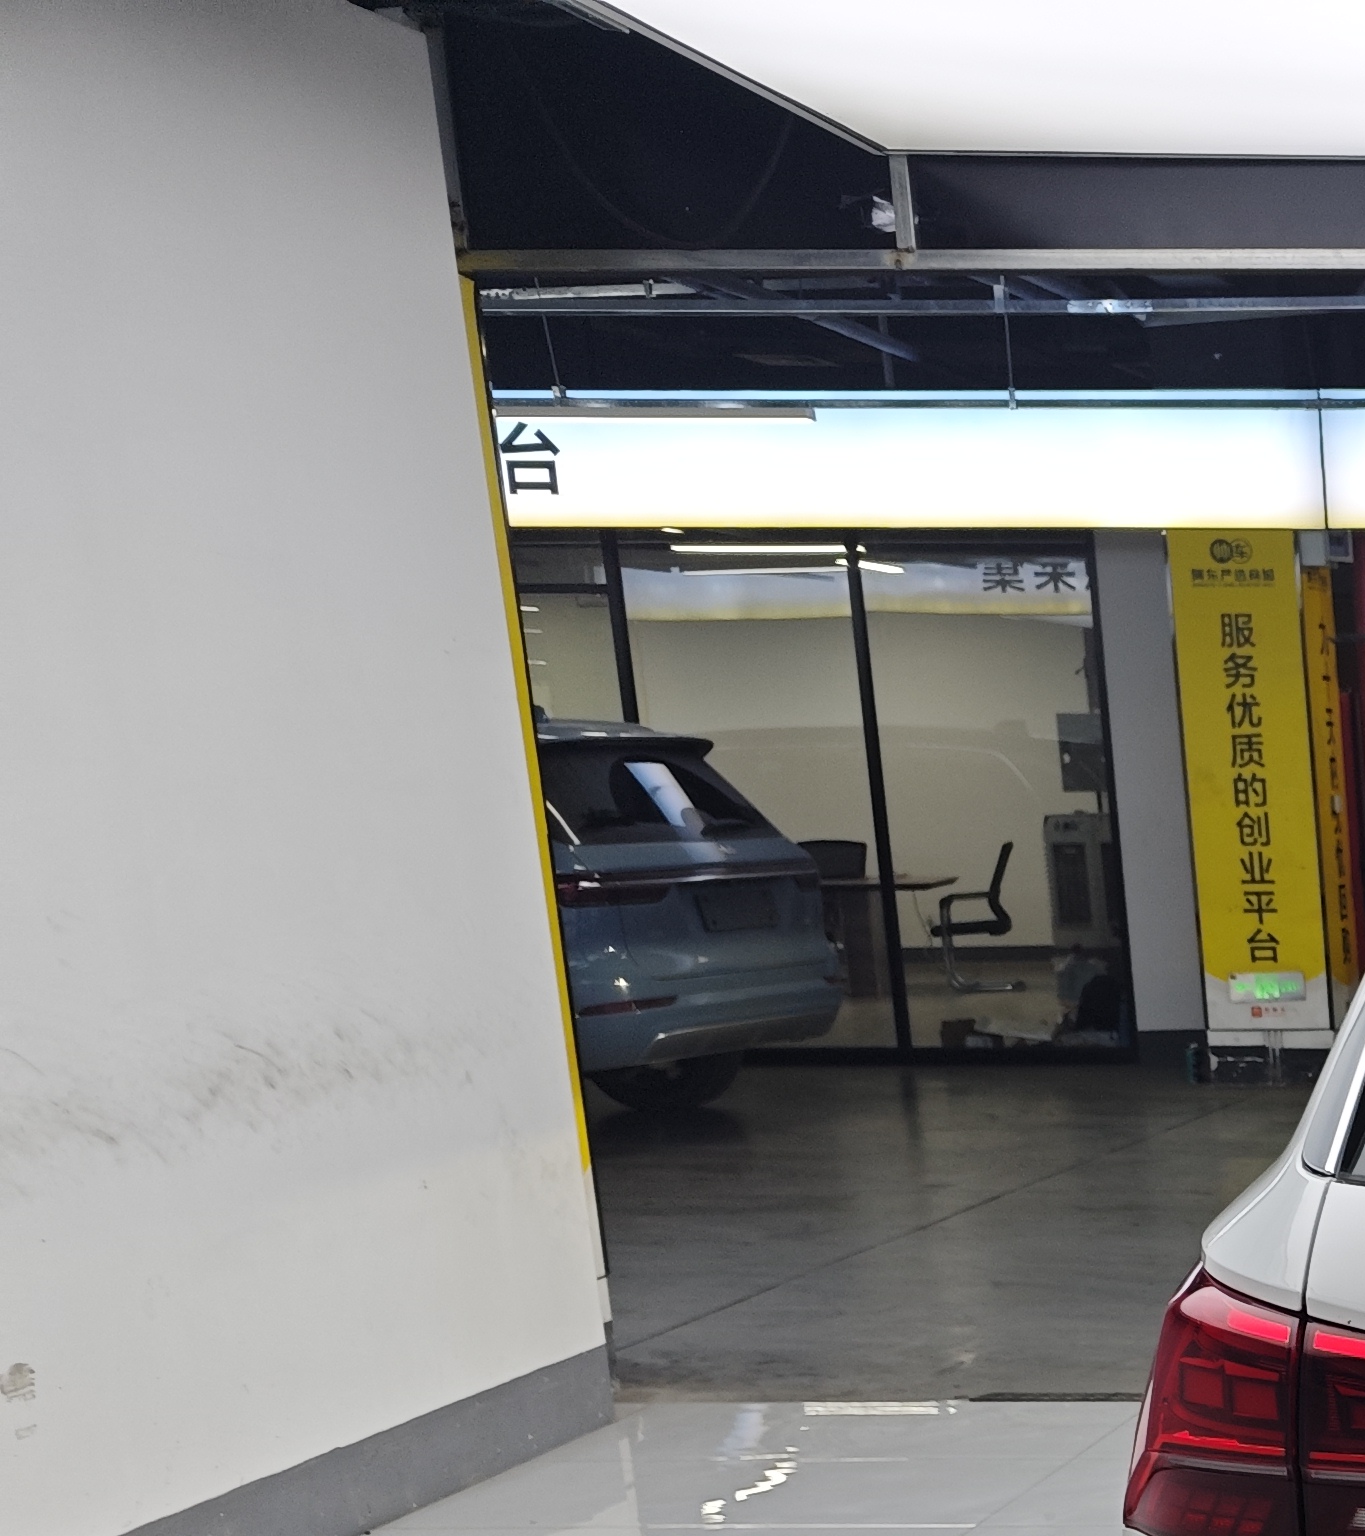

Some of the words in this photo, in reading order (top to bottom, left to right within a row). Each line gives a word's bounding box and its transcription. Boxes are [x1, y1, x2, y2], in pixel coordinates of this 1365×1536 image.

[500, 421, 560, 495] 台
[1220, 612, 1280, 963] 服务优质的创业平台
